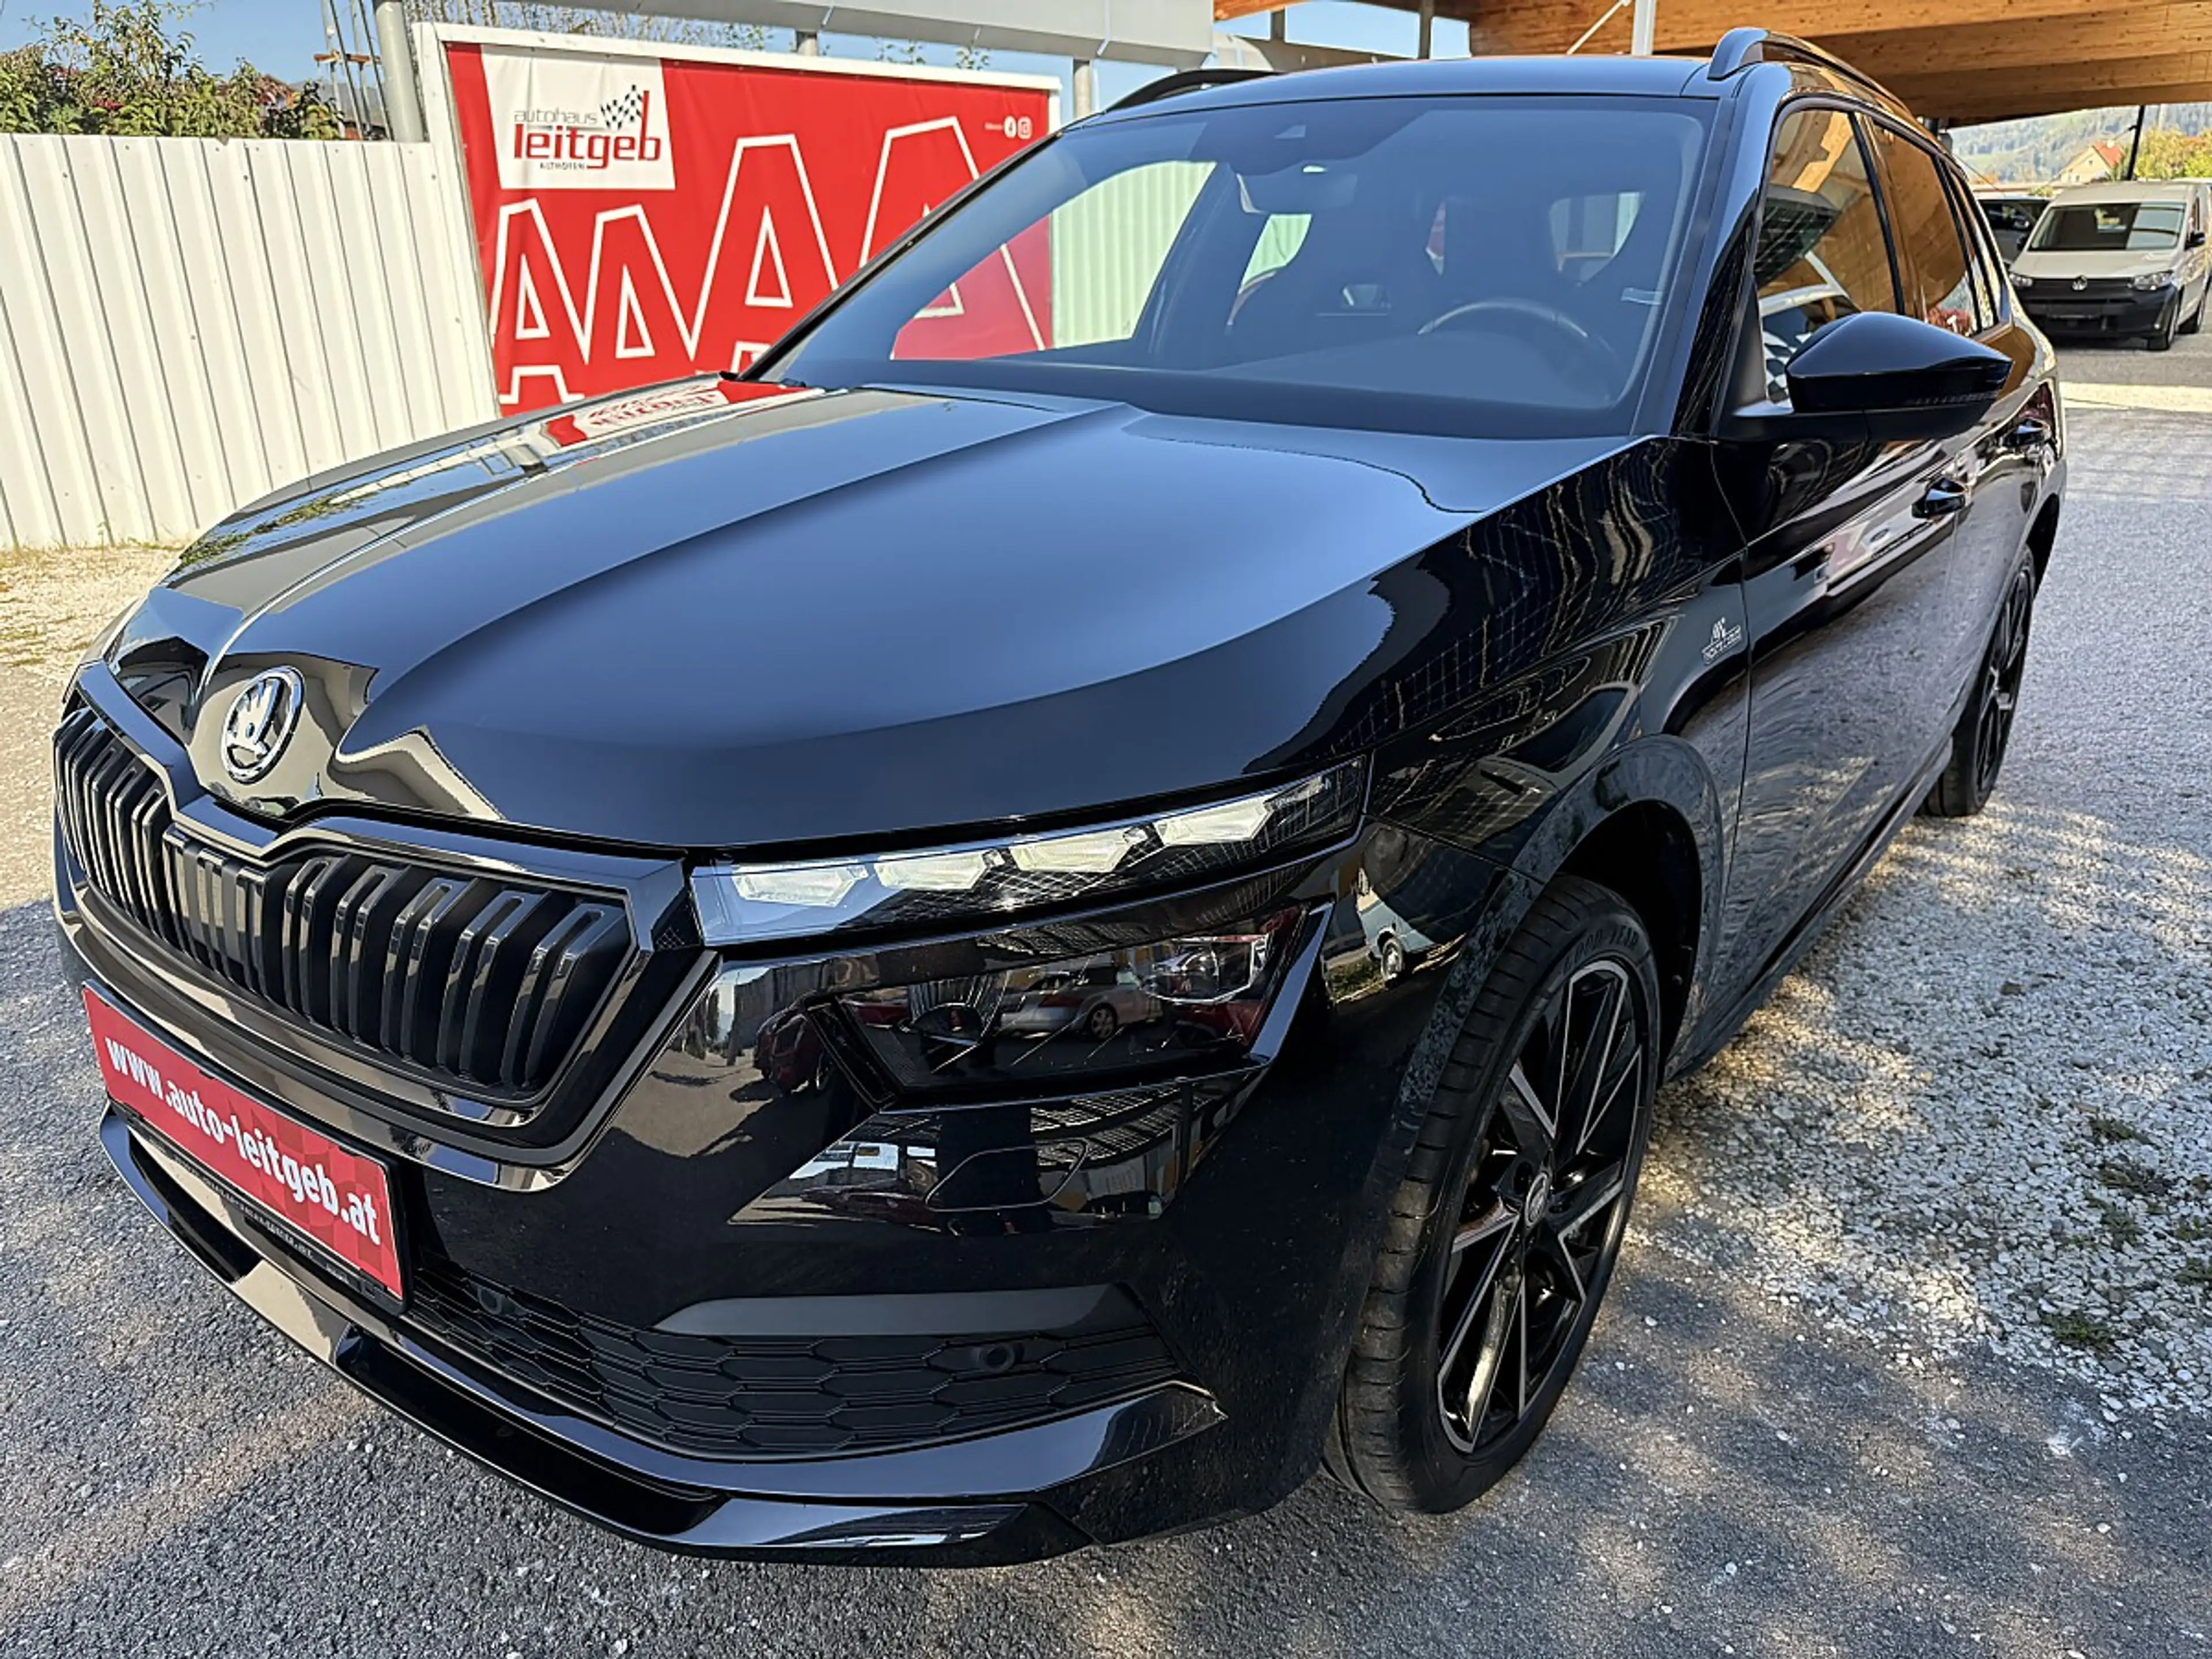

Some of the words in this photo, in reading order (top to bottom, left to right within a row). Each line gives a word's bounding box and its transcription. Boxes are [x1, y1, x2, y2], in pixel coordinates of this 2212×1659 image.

[514, 108, 598, 124] autohaus
[514, 90, 661, 169] leitgeb
[105, 1037, 381, 1245] www.auto-leitgeb.at
